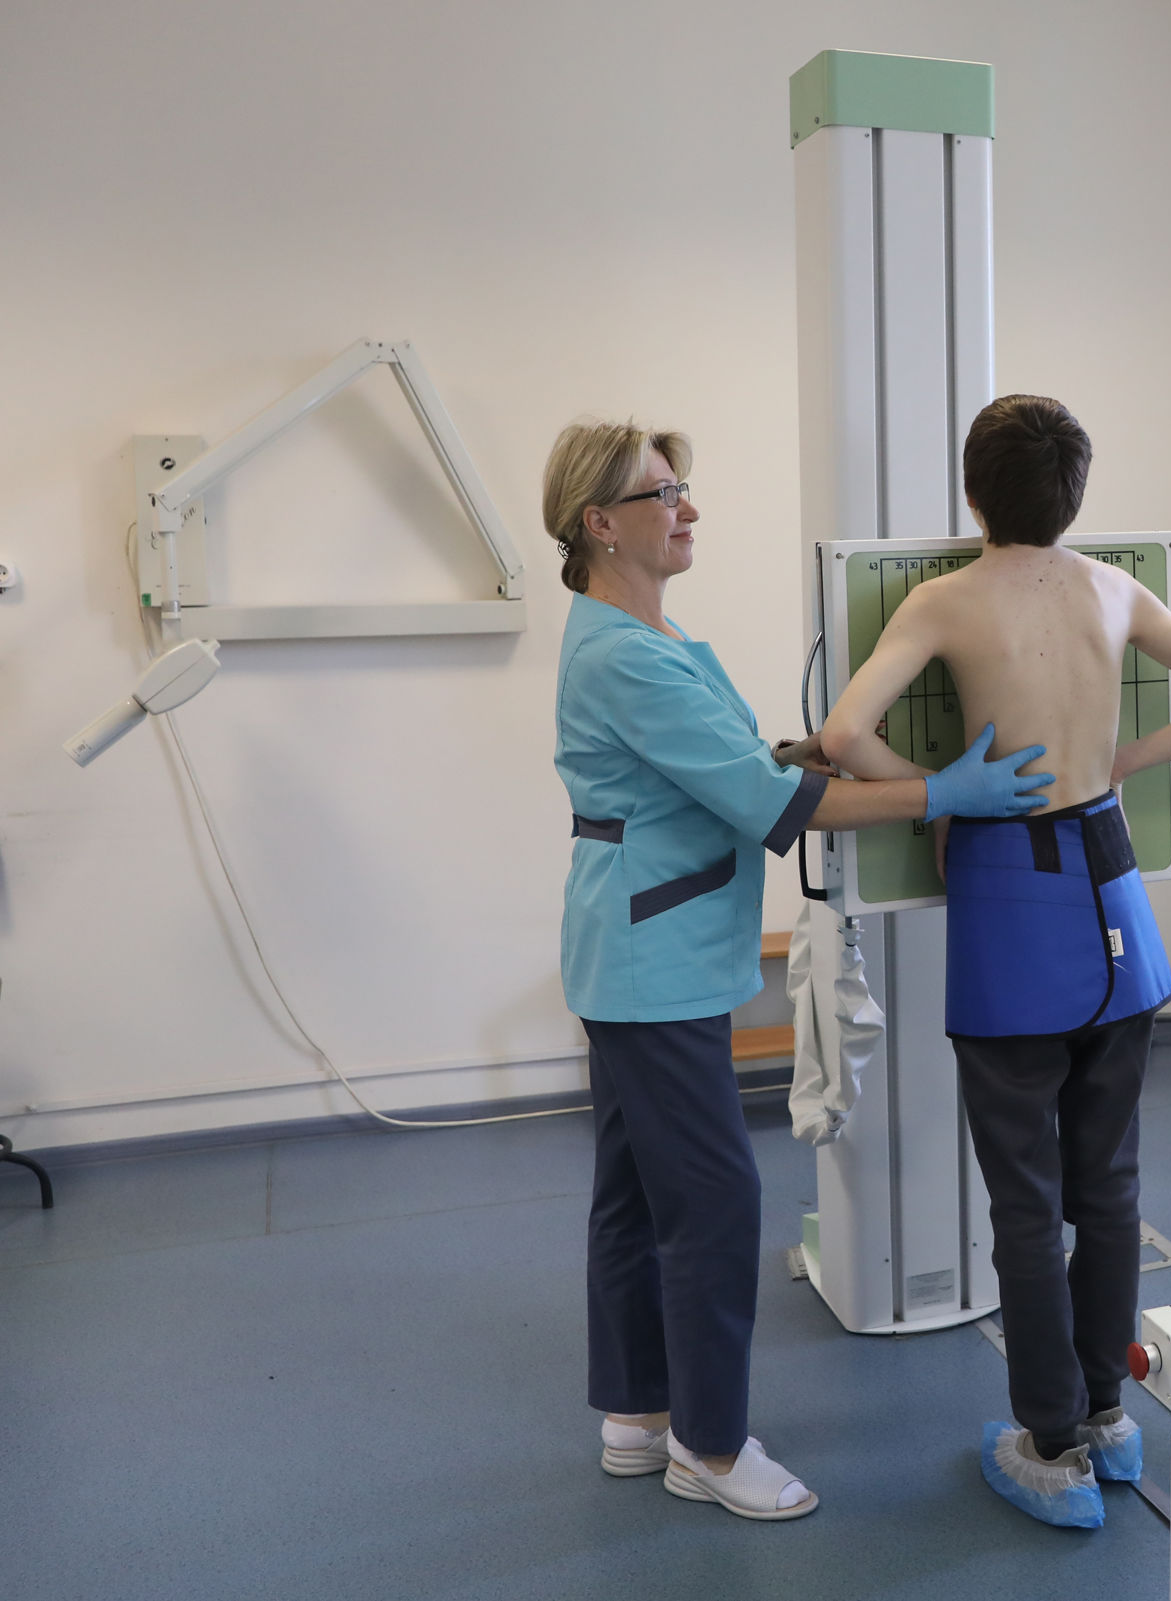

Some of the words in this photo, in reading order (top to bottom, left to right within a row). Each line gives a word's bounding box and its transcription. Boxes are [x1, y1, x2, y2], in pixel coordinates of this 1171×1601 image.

[1114, 554, 1122, 563] 35
[1136, 554, 1145, 562] 43
[868, 562, 879, 571] 43
[895, 561, 904, 570] 35
[909, 561, 918, 570] 30
[928, 560, 938, 569] 24
